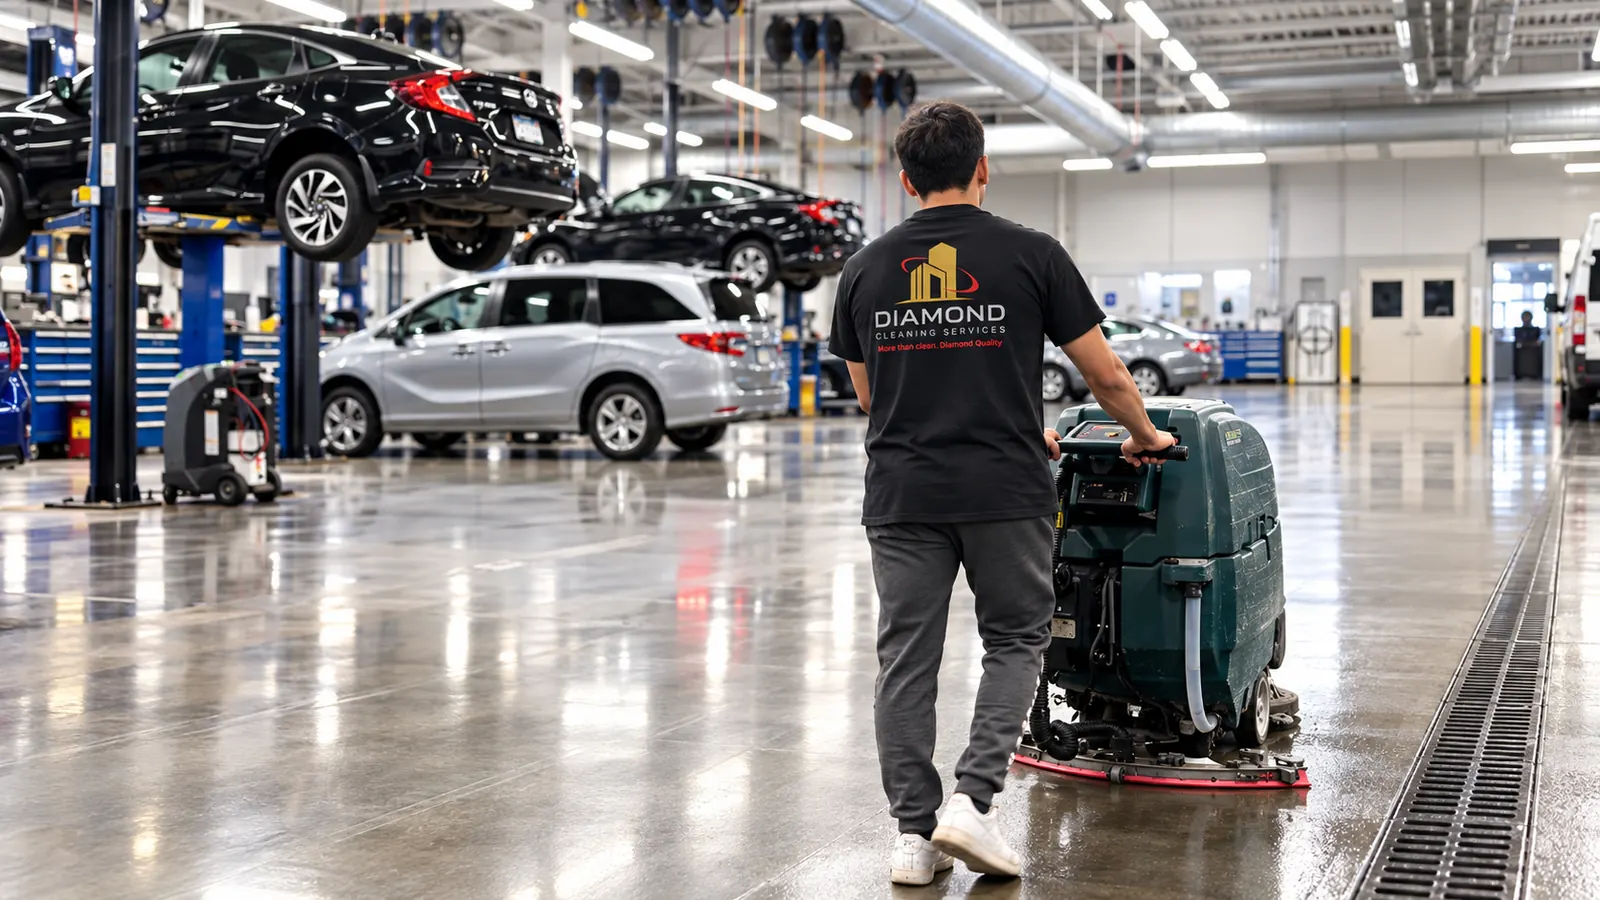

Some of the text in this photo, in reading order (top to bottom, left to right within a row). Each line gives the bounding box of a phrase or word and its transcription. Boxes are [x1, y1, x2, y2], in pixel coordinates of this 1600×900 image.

[875, 304, 1006, 328] DIAMOND
[875, 326, 1006, 340] CLEANING SERVICES
[940, 340, 973, 348] Diamond
[975, 339, 1002, 348] Quality
